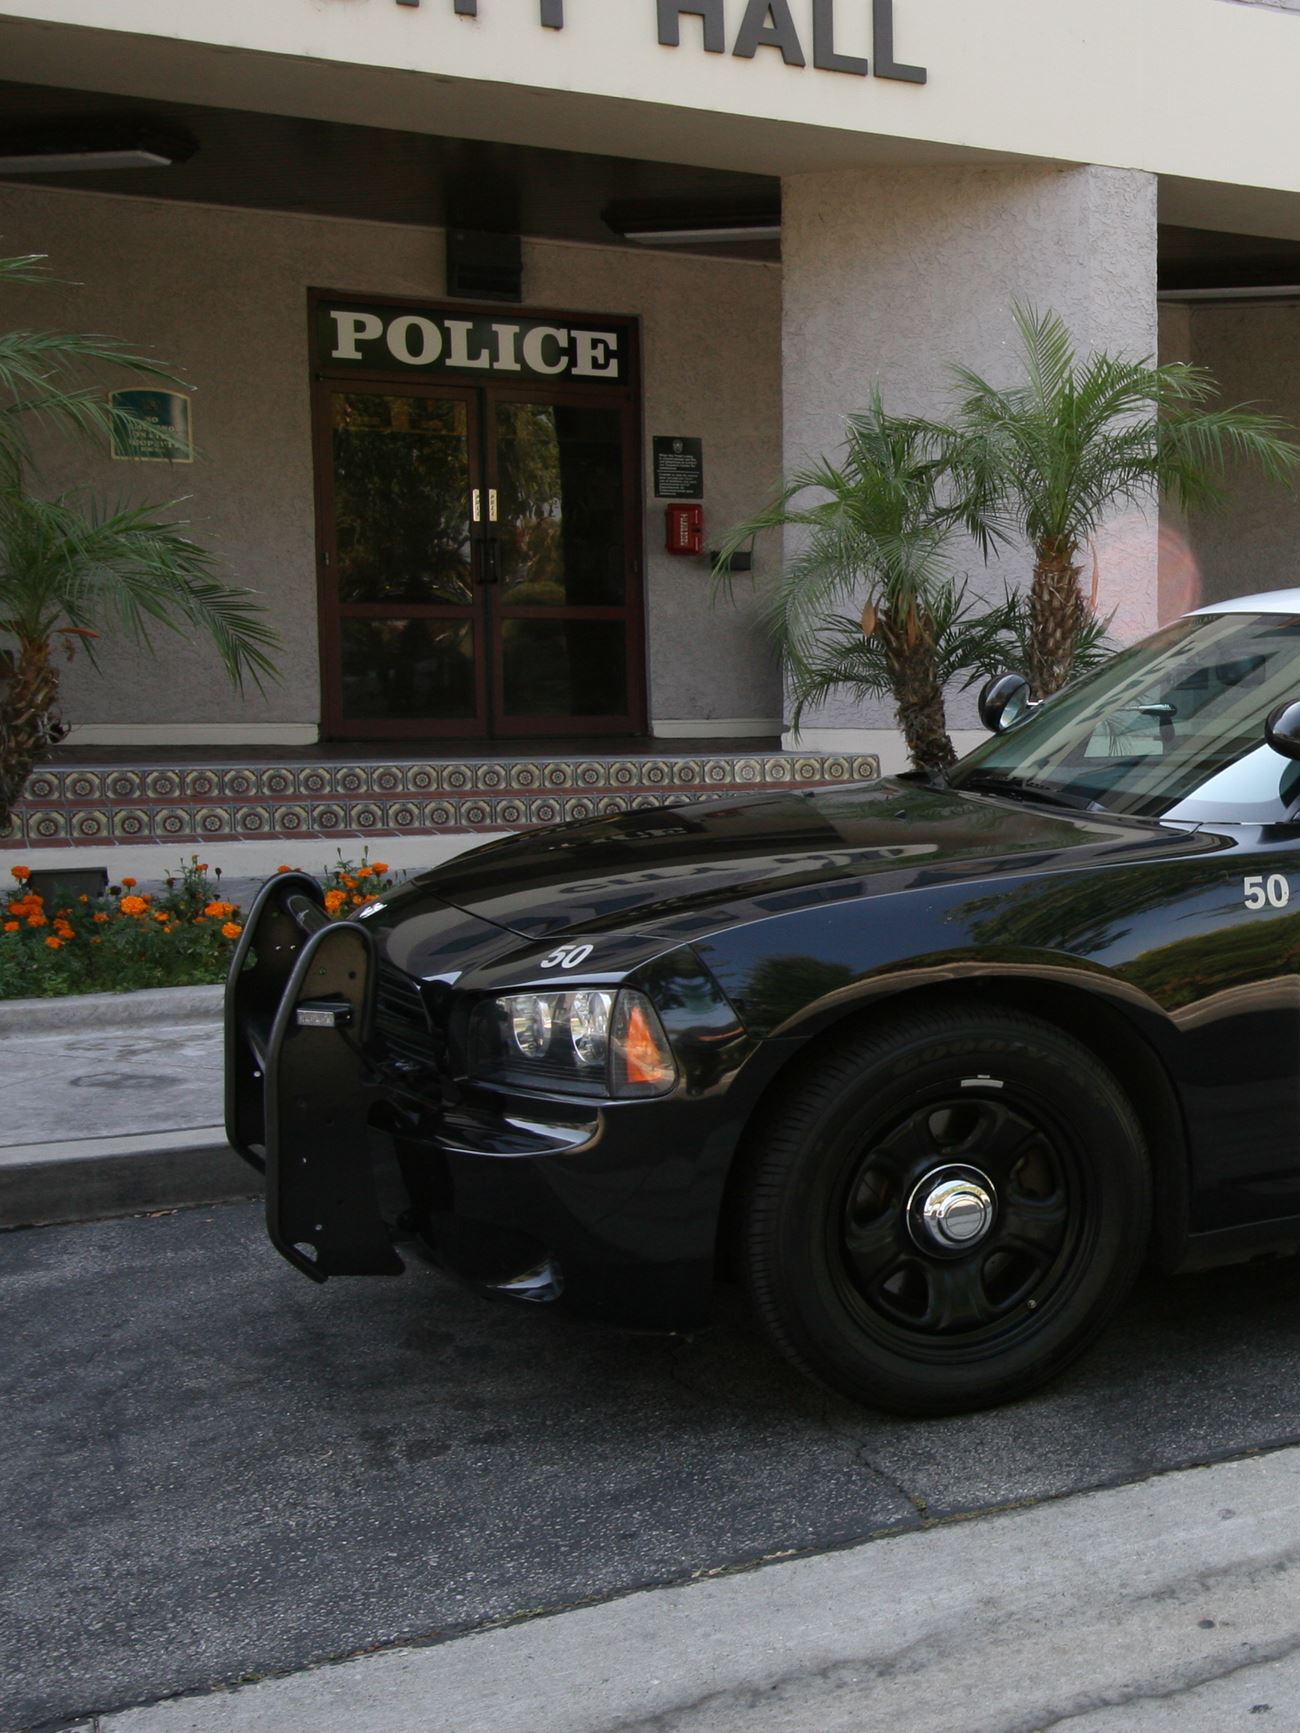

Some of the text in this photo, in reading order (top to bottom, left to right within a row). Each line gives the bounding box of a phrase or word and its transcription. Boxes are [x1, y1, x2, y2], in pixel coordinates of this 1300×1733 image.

[657, 0, 927, 84] HALL
[330, 310, 619, 378] POLICE
[1243, 873, 1290, 910] 50
[540, 944, 594, 969] 50
